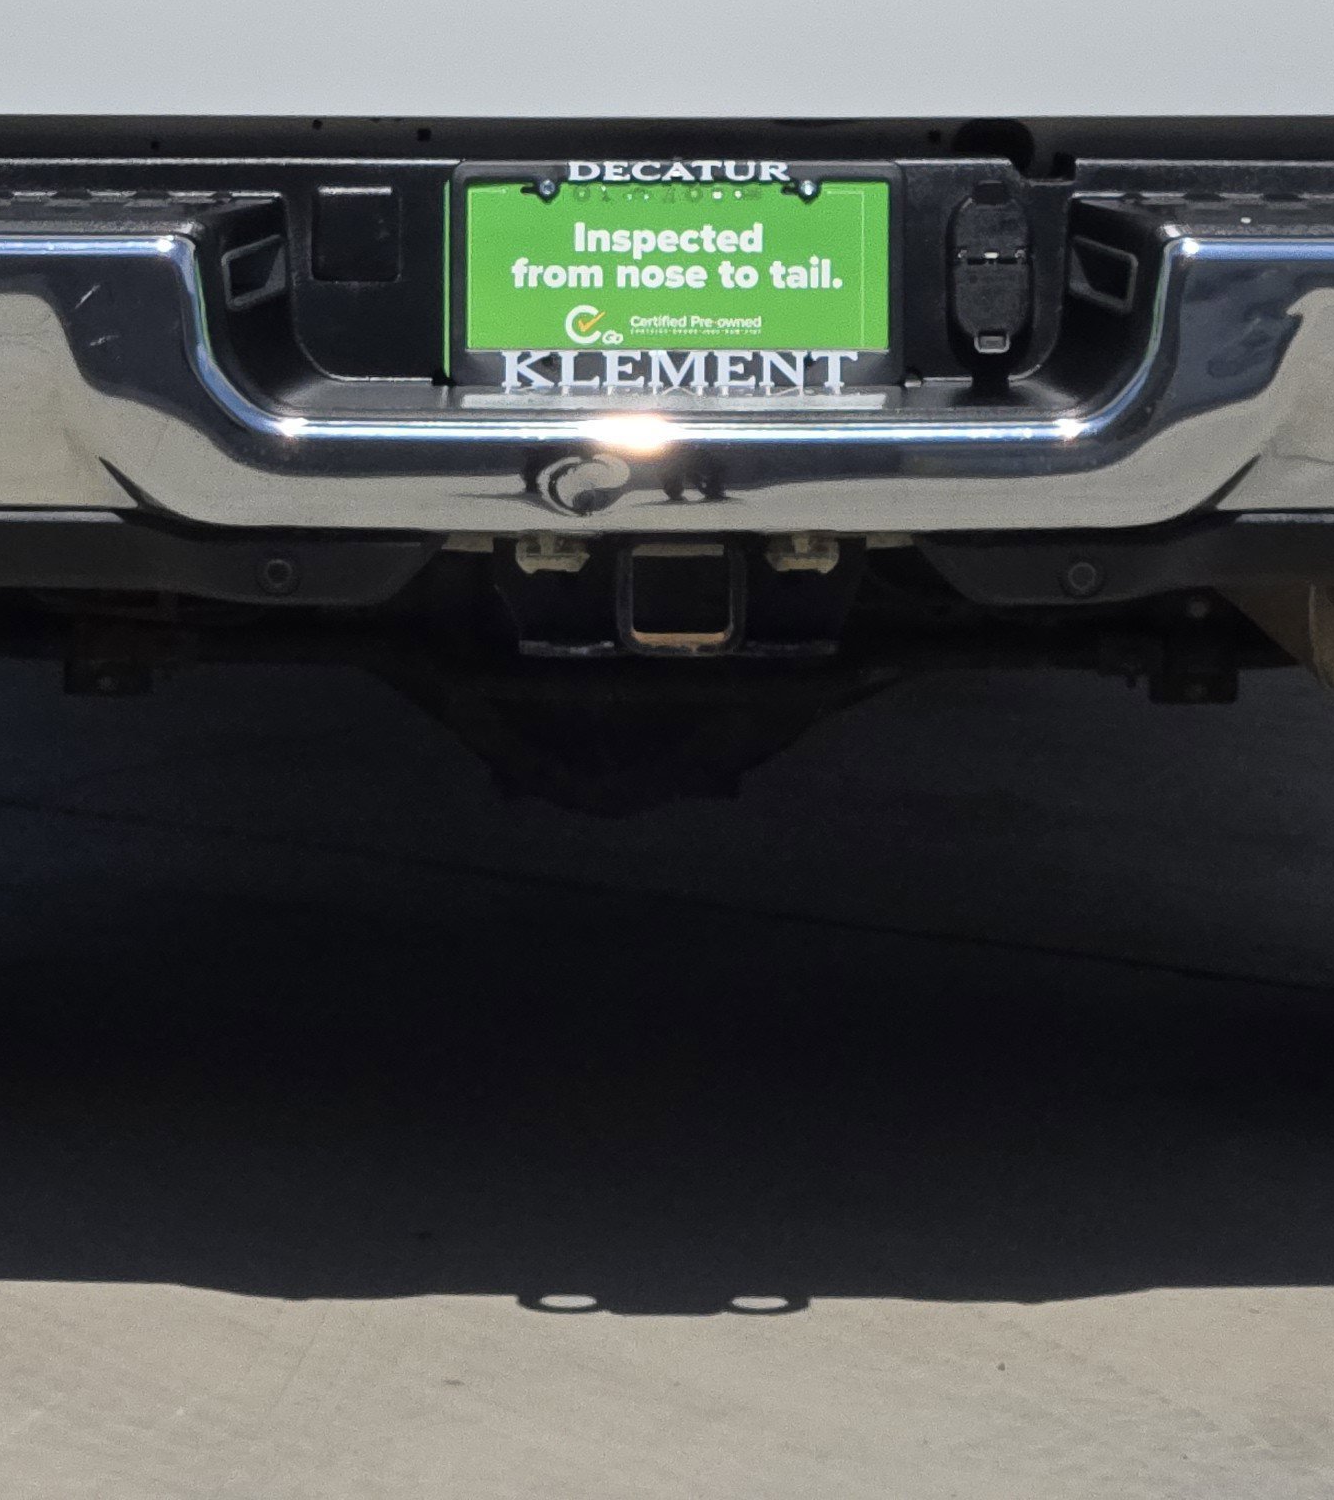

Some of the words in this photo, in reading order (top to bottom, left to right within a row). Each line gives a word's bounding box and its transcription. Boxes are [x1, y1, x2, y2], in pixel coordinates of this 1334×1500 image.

[568, 161, 790, 182] DECATUR
[575, 222, 764, 260] Inspected
[511, 257, 604, 290] from
[617, 265, 708, 290] nose
[718, 260, 759, 289] to
[770, 256, 844, 290] tail.
[630, 315, 687, 327] Certified
[690, 315, 762, 328] Pre-owned
[501, 351, 859, 387] KLEMENT
